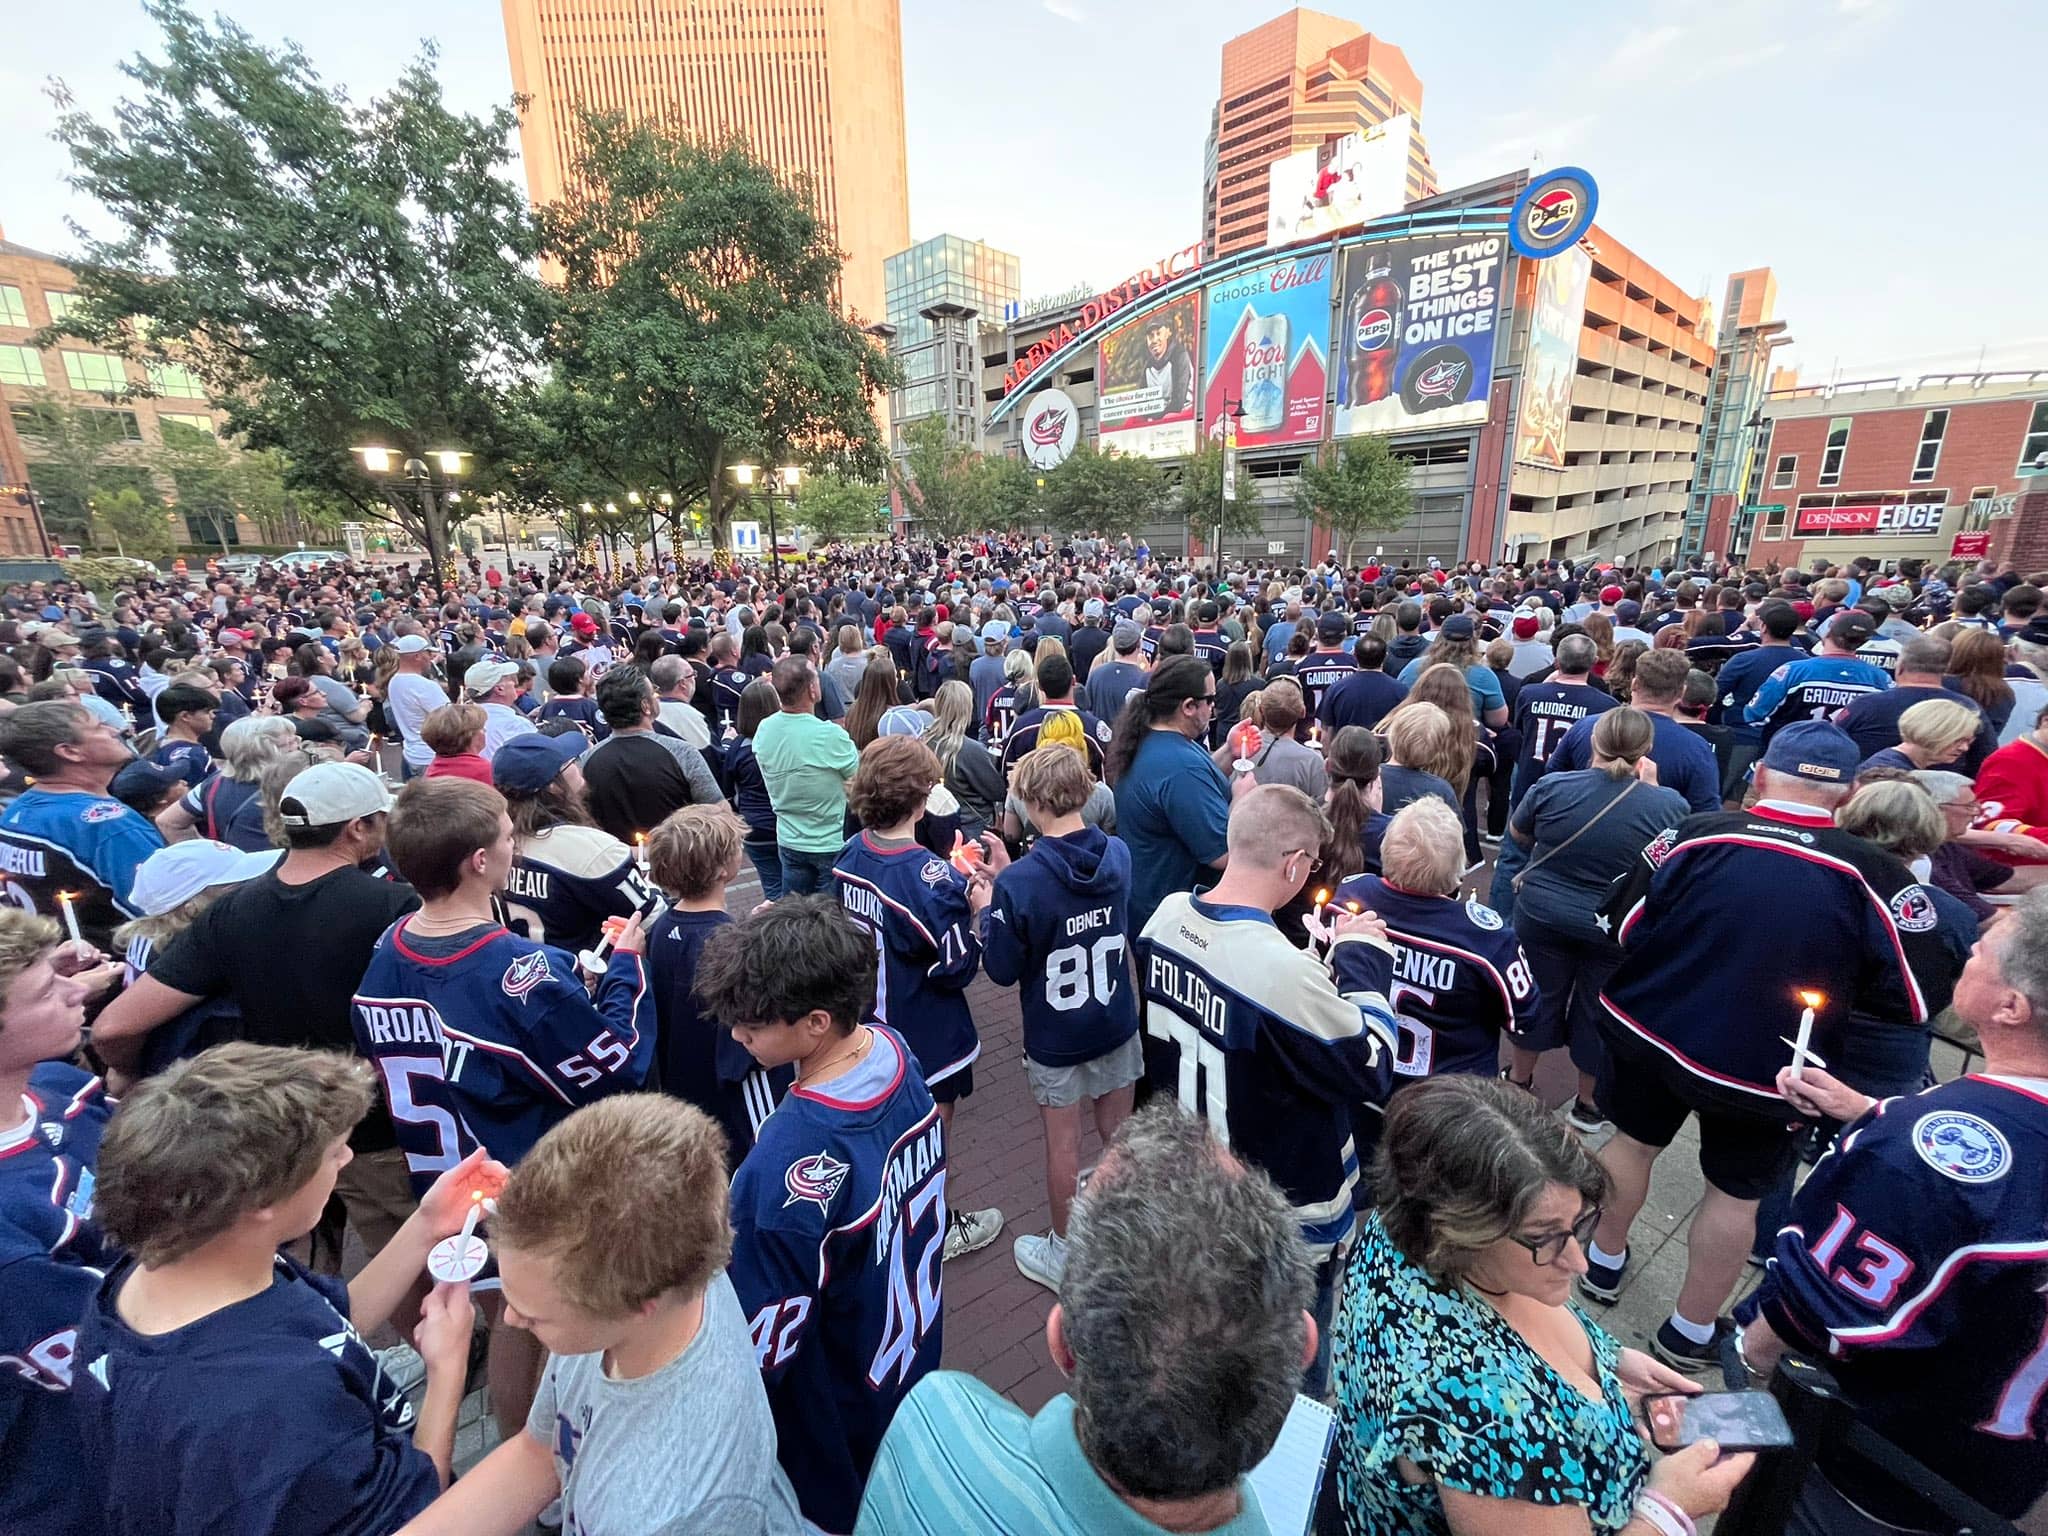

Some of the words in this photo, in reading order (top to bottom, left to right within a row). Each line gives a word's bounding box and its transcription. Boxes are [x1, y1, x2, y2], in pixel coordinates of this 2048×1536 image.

[1532, 204, 1573, 223] PESI
[1411, 251, 1449, 273] THE
[1452, 238, 1500, 263] TWO
[1214, 281, 1265, 304] CHOOSE
[1270, 256, 1329, 293] Chill
[1409, 257, 1498, 301] BEST
[1024, 281, 1094, 314] Nationwide
[1408, 286, 1495, 322] THINGS
[1003, 323, 1076, 396] ARENA
[1081, 241, 1207, 330] DISTRICT
[1358, 323, 1390, 336] PEPSI
[1405, 317, 1447, 345] ON
[1449, 309, 1493, 339] ICE
[1244, 364, 1284, 383] LIGHT
[1806, 512, 1872, 525] DENISON
[1877, 503, 1944, 528] EDGE
[1531, 701, 1587, 719] GAUDREAU
[1066, 906, 1112, 937] OBNEY
[1179, 925, 1209, 952] Reebok
[1046, 933, 1125, 1012] 80
[557, 1031, 630, 1088] 55
[1810, 1202, 1915, 1307] 13
[749, 1296, 812, 1368] 42
